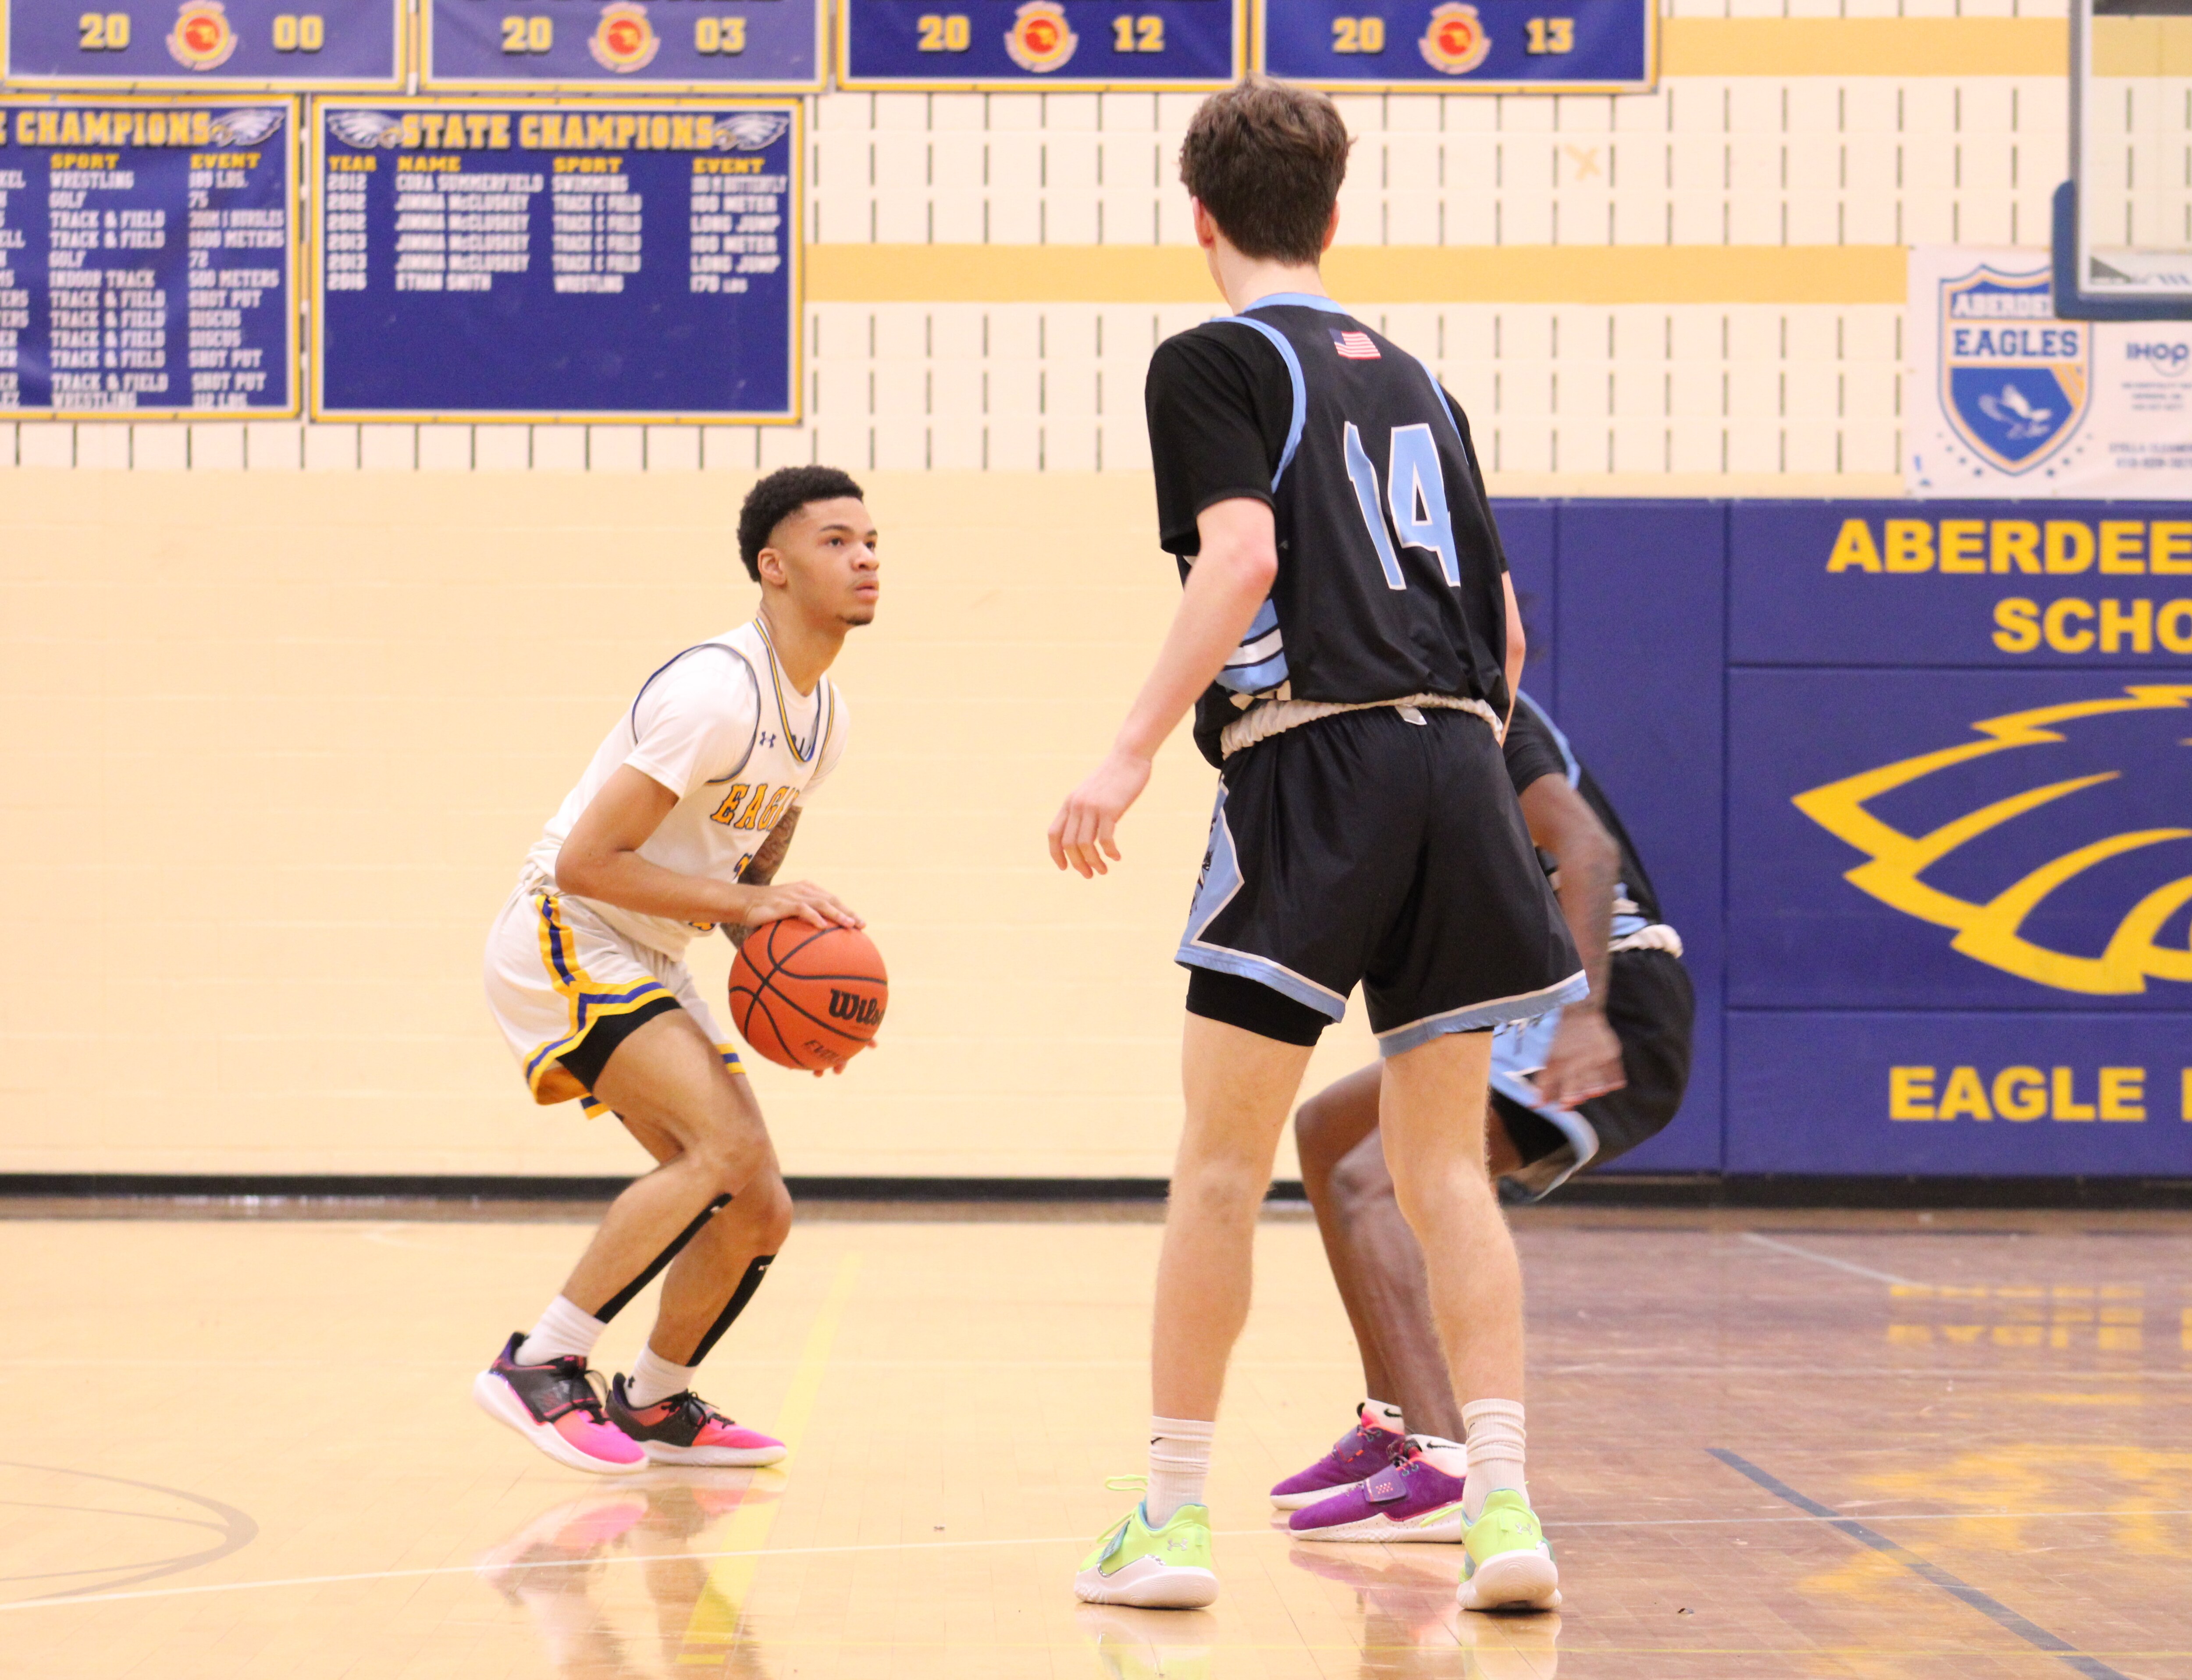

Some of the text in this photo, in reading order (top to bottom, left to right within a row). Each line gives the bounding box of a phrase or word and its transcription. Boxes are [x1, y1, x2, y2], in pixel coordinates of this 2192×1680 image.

[79, 13, 324, 51] 20 00
[502, 16, 747, 53] 20 03
[918, 15, 1164, 52] 20 12
[1331, 17, 1575, 53] 20 13
[16, 110, 212, 146] CHAMPIONS
[402, 114, 715, 150] STATE CHAMPIONS
[50, 153, 120, 170] SPORT
[190, 153, 261, 169] EVENT
[328, 156, 377, 172] YEAR
[397, 156, 461, 172] NAME
[552, 157, 623, 173] SPORT
[692, 157, 765, 174] EVENT
[1954, 329, 2078, 356] EAGLES
[1344, 421, 1461, 590] 14
[1826, 519, 2192, 574] ABERDEE
[1890, 1066, 2146, 1121] EAGLE
